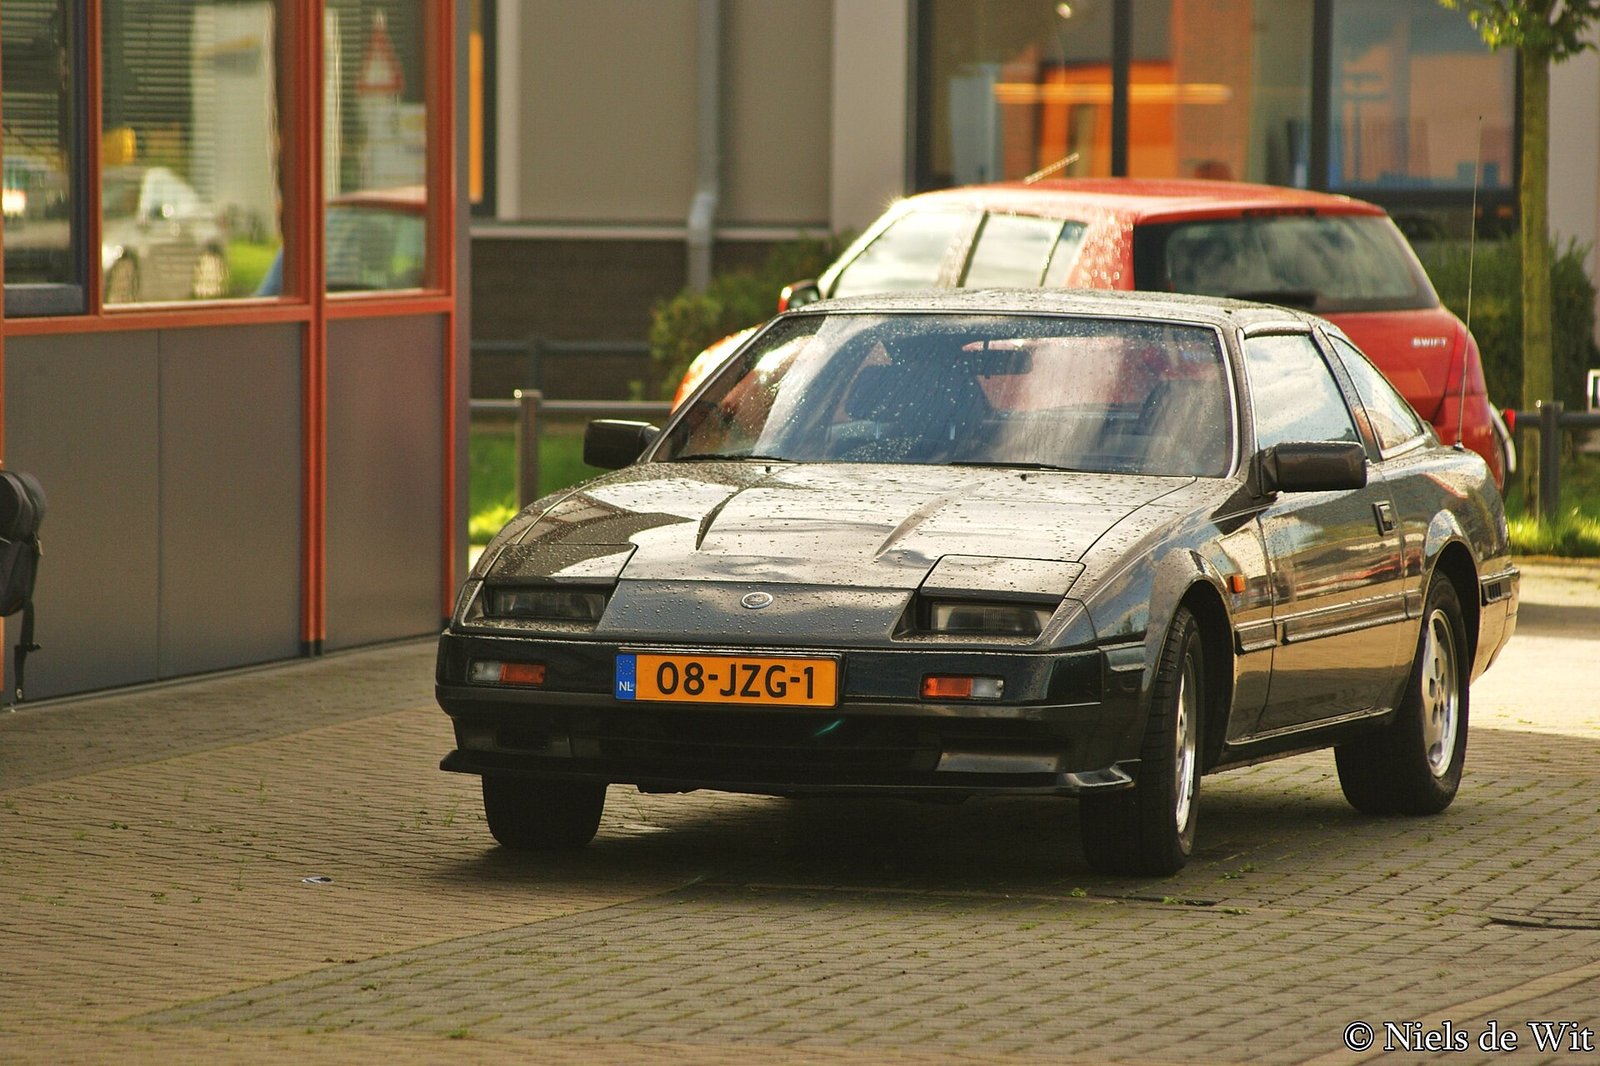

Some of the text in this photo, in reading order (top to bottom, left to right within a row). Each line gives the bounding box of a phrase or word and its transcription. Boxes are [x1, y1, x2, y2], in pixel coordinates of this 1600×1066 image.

[1411, 337, 1447, 348] SWIFT
[656, 661, 814, 699] 08-JZG-1
[619, 681, 633, 692] NL
